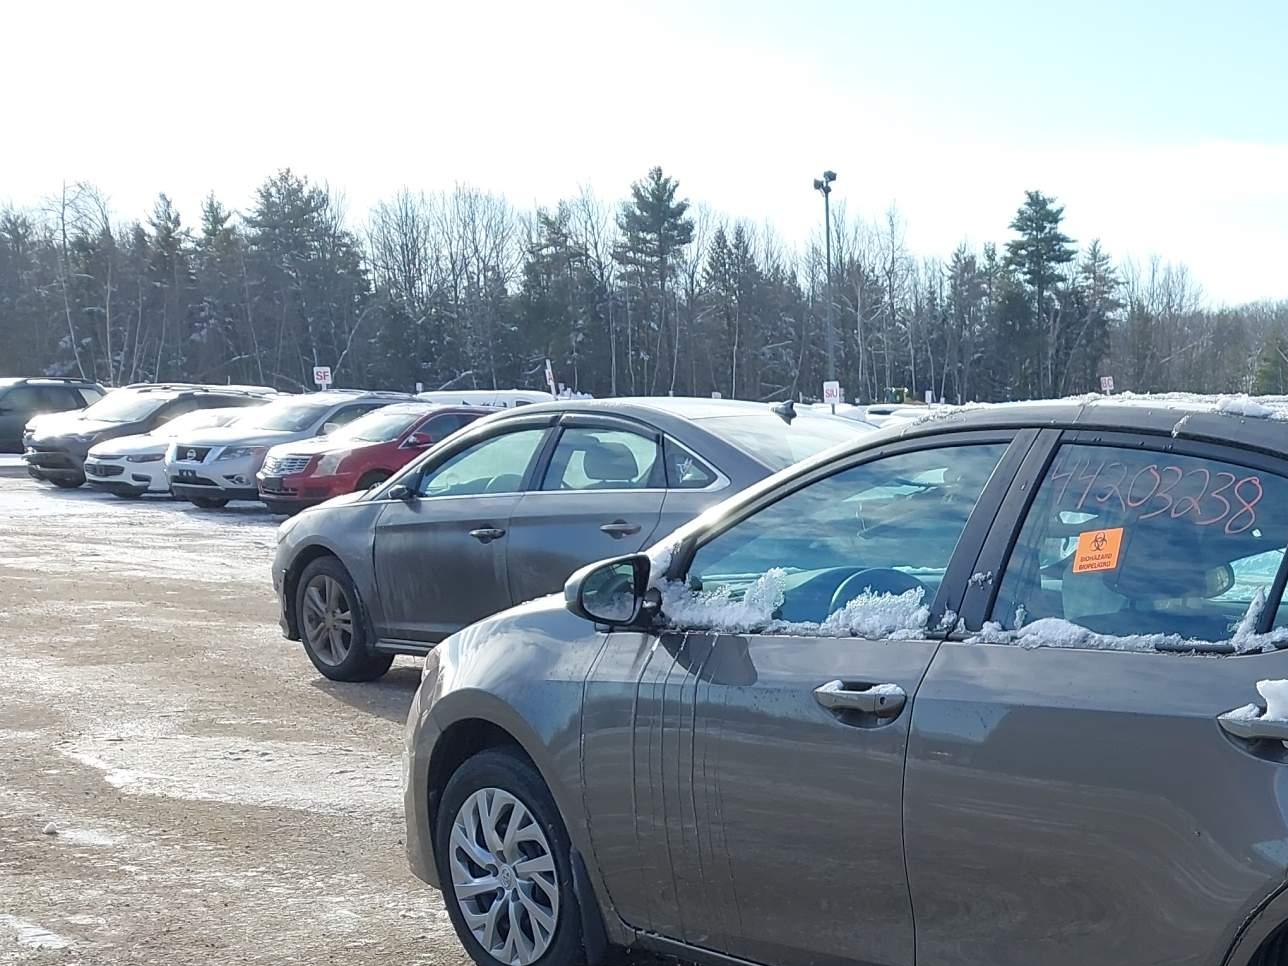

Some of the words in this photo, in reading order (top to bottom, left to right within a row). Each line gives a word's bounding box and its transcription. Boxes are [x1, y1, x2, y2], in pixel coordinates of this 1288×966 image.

[316, 371, 329, 381] SF
[1051, 459, 1263, 534] 44203238
[1080, 553, 1112, 563] BIOHAZARD
